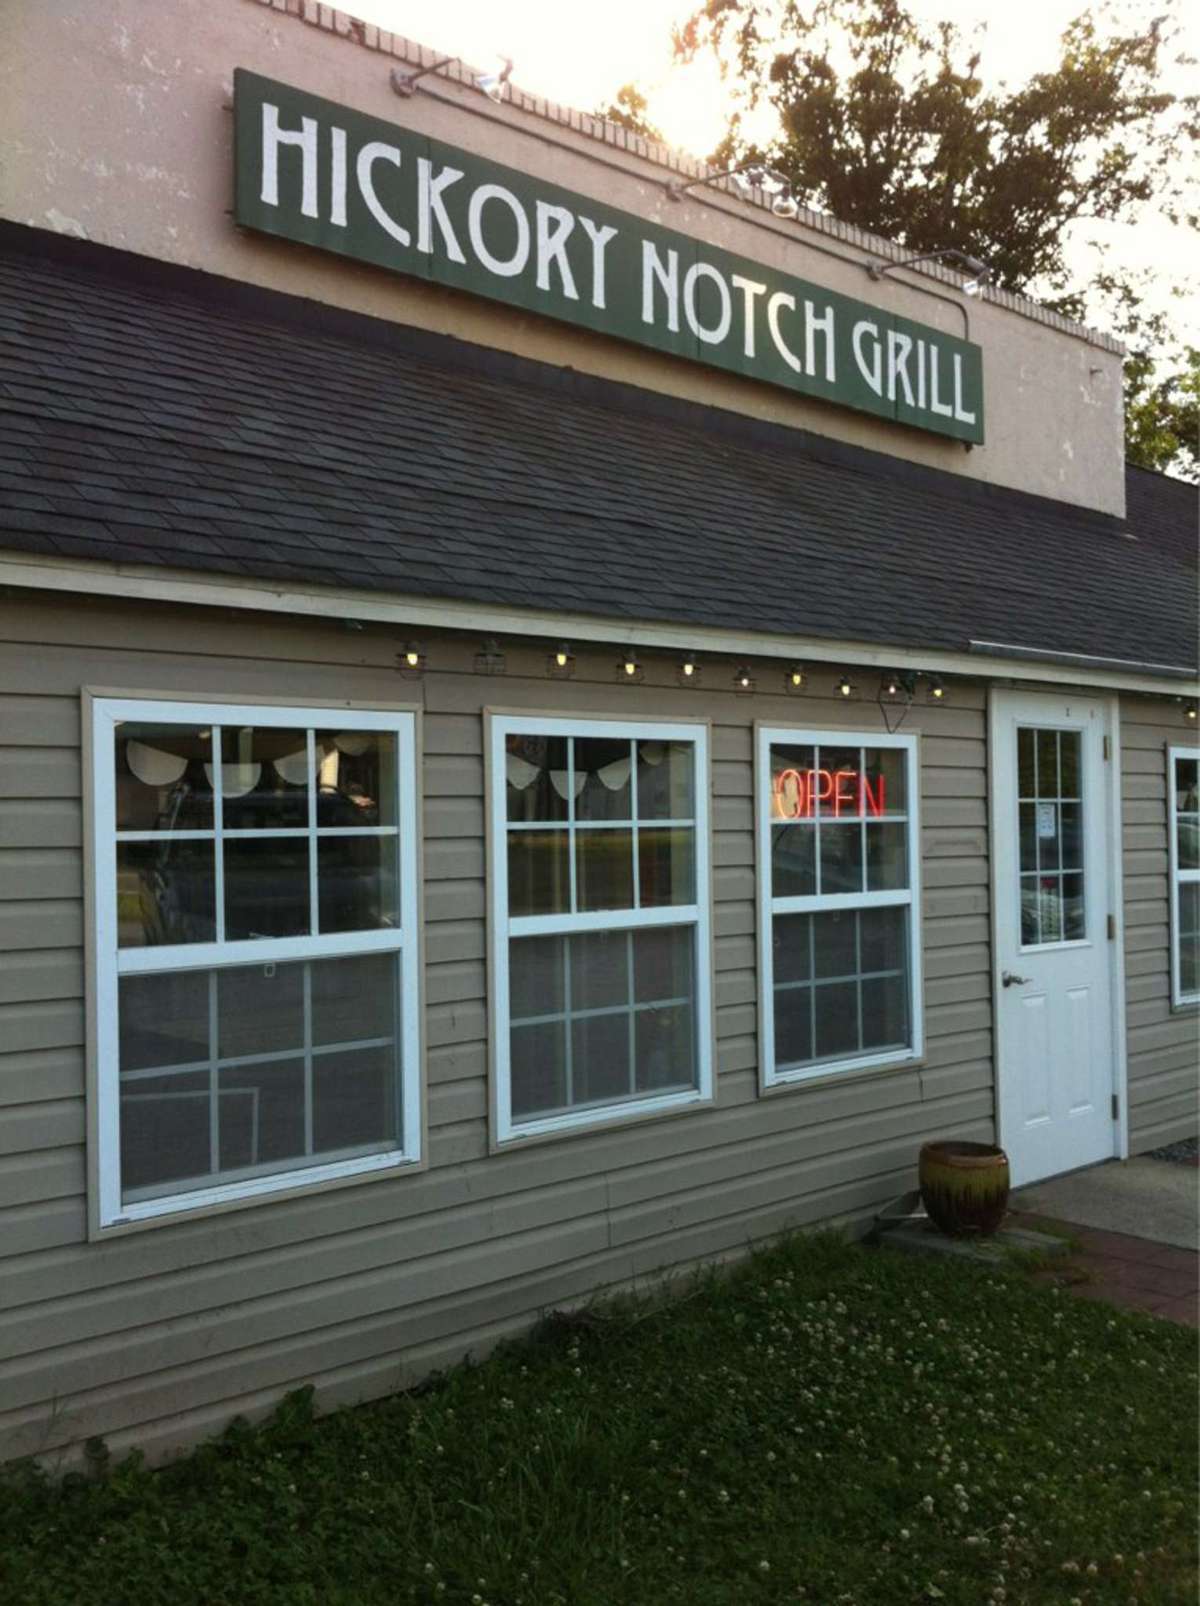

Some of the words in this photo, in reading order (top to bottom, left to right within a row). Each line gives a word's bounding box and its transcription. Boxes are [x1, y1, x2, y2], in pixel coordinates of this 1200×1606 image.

[261, 103, 618, 309] HICKORY
[642, 240, 835, 382] NOTCH
[852, 320, 975, 424] GRILL
[774, 769, 886, 819] OPEN
